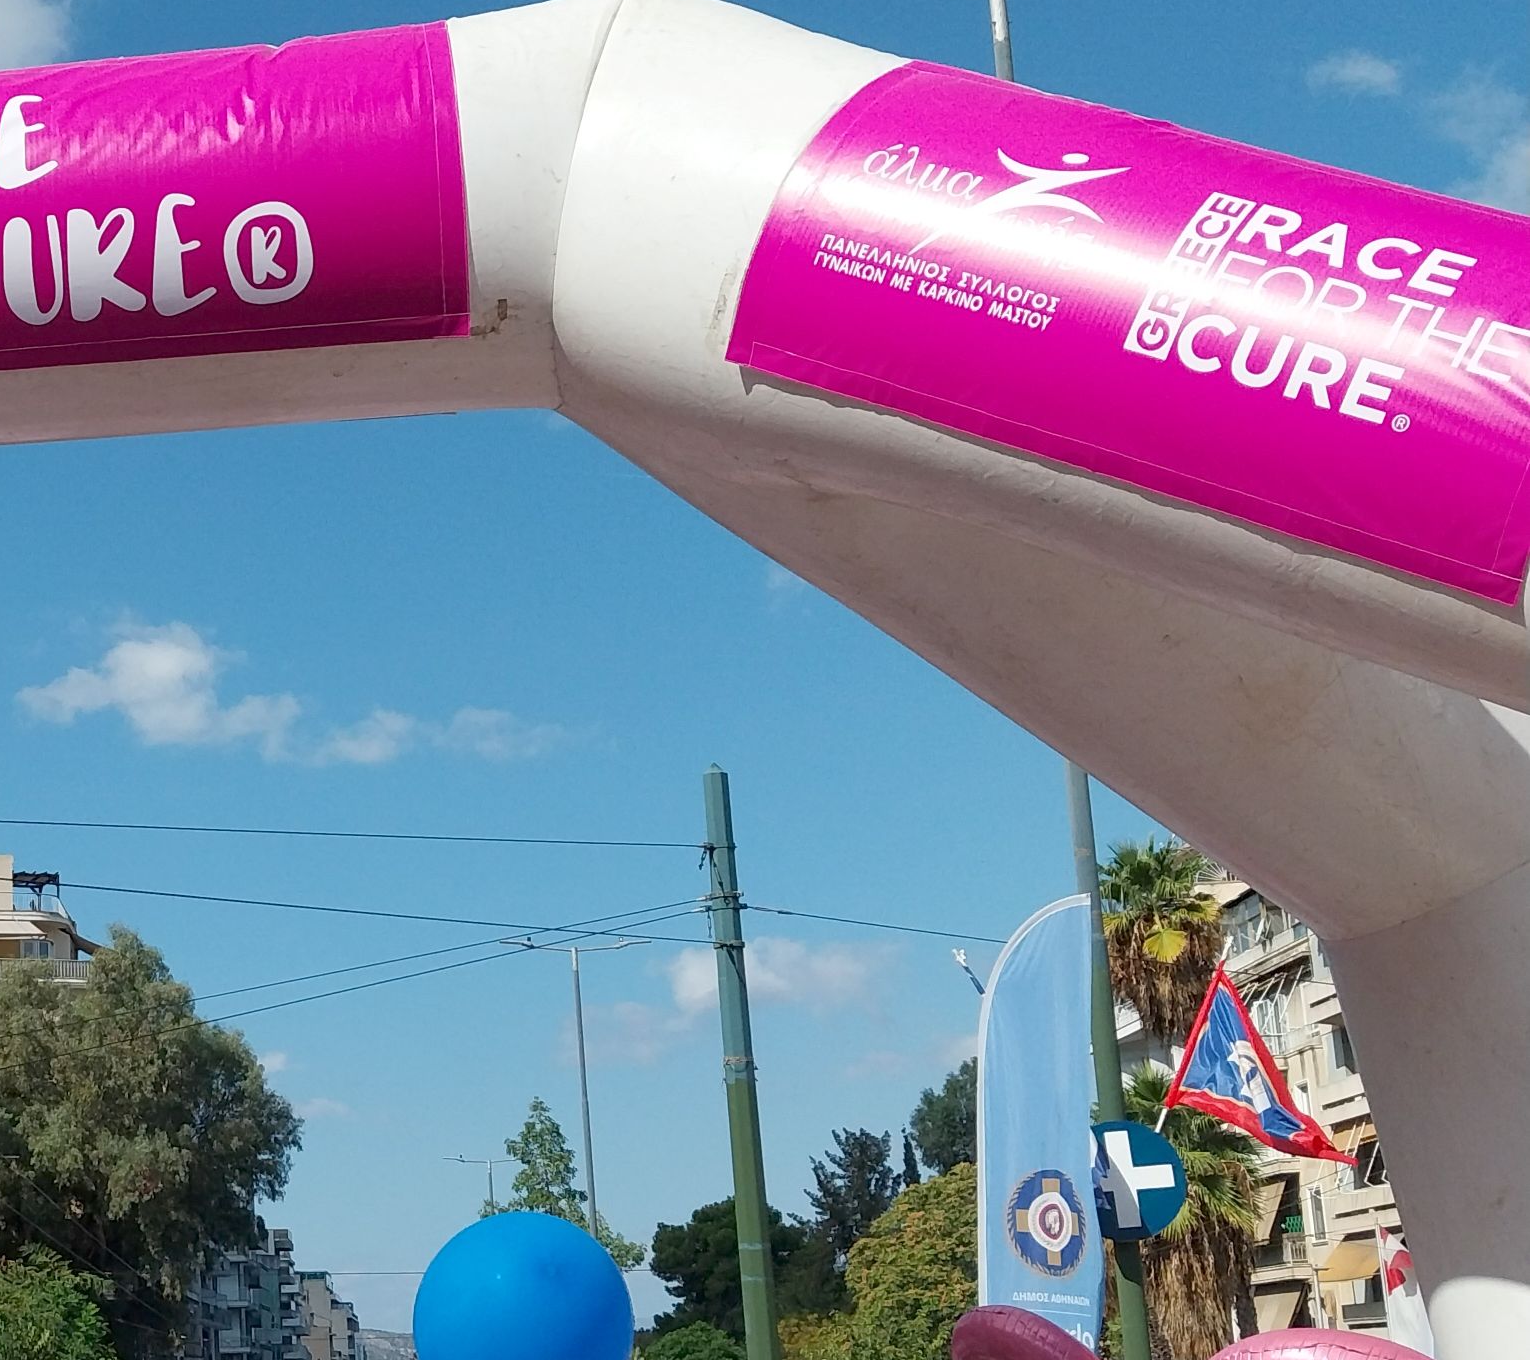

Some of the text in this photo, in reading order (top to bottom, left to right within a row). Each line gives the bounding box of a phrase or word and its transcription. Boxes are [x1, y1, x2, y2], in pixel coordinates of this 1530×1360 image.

[820, 233, 1062, 314] ΠΑΝΕΛΛΗΝΙΟΣ ΣΥΛΛΟΓΟΣ
[1236, 203, 1478, 297] RACE
[814, 251, 1053, 332] ΓΥΝΑΙΚΩΝ ΜΕ ΚΑΡΚΙΝΟ ΜΑΣΤΟΥ
[1378, 293, 1530, 383] THE
[1013, 1292, 1049, 1302] ΔΗΜΟΣ
